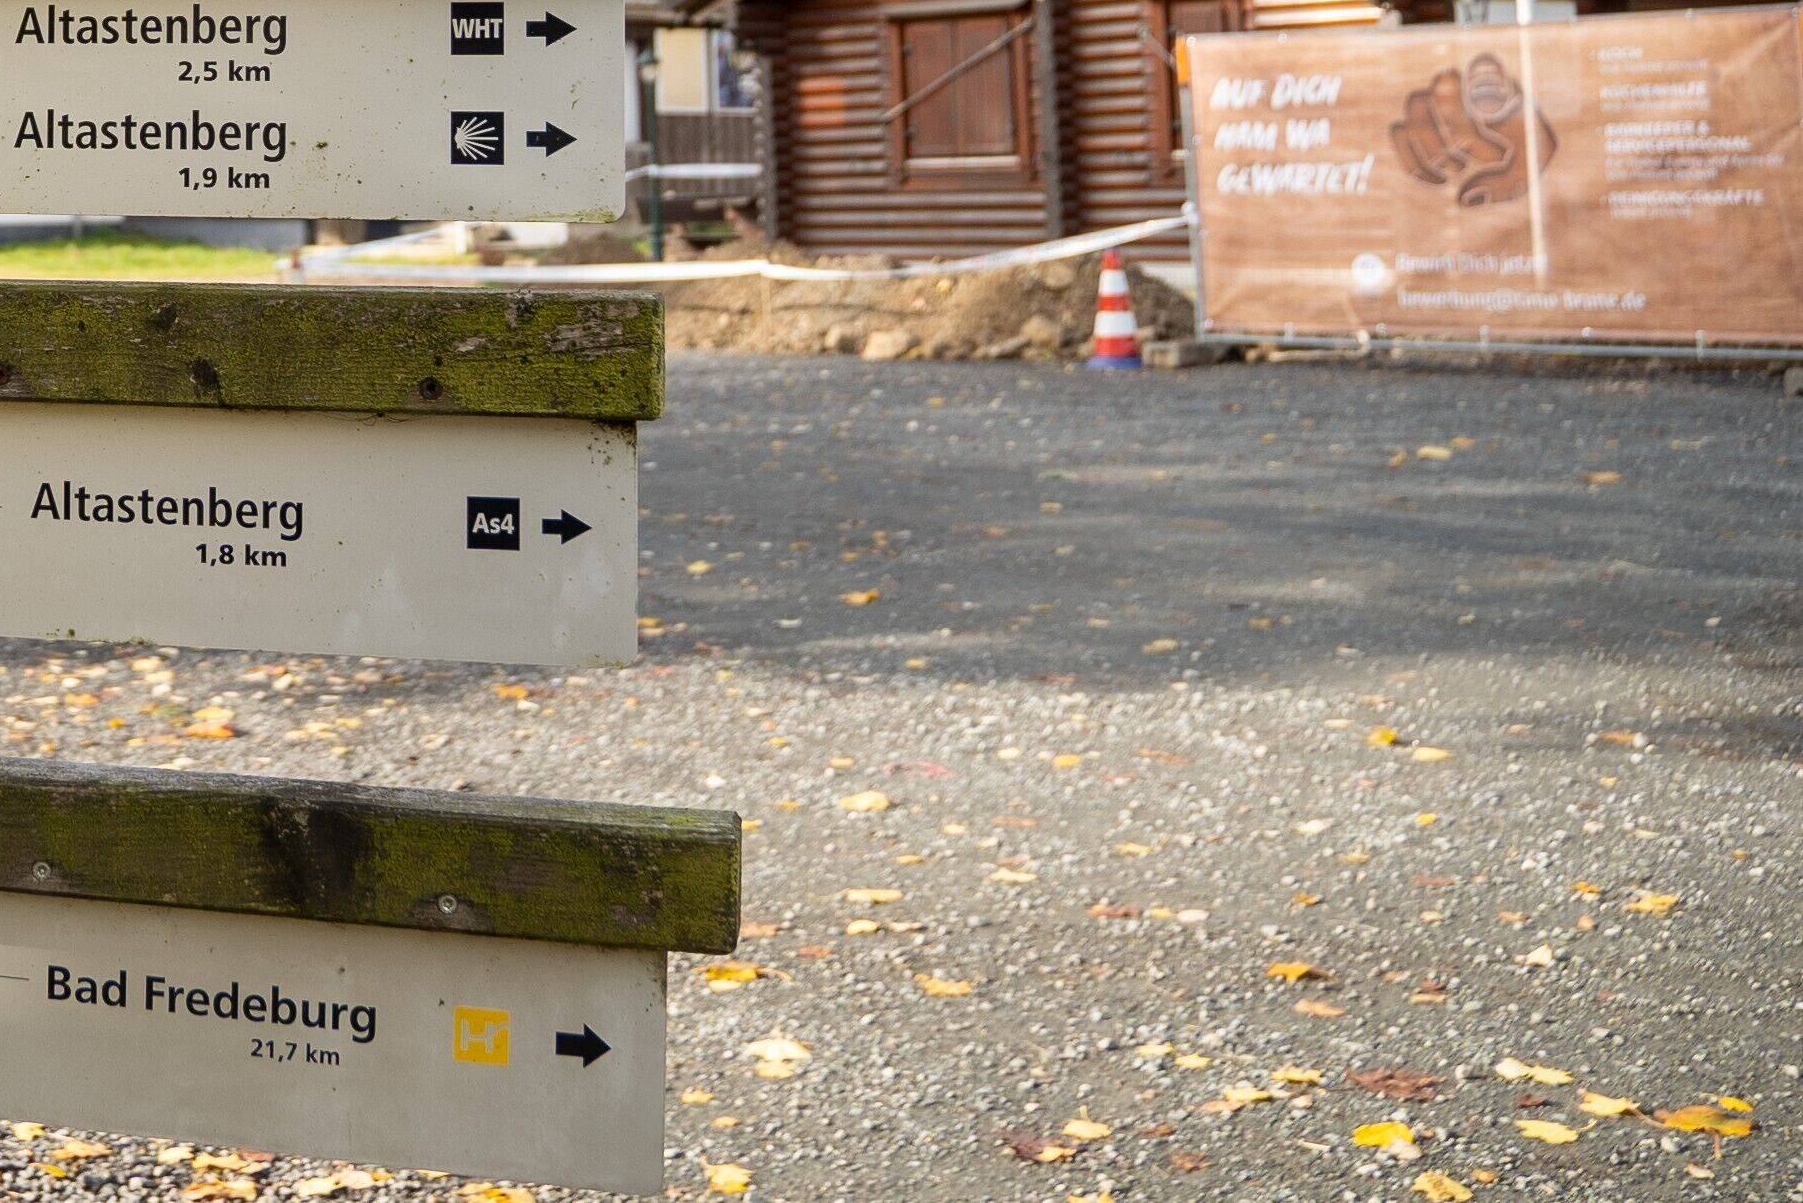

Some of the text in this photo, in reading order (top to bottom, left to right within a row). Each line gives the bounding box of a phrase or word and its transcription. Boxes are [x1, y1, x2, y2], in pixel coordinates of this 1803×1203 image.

[14, 3, 287, 56] Altastenberg
[451, 18, 504, 39] WHT
[178, 59, 271, 85] 2,5 km
[1209, 73, 1342, 109] AUF DICH
[13, 108, 287, 163] Altastenberg
[178, 166, 270, 191] 1,9 km
[30, 480, 303, 542] Altastenberg
[472, 512, 515, 534] As4
[195, 543, 287, 568] 1,8 km
[47, 964, 377, 1044] Bad Fredeburg
[250, 1038, 340, 1066] 21,7 km
